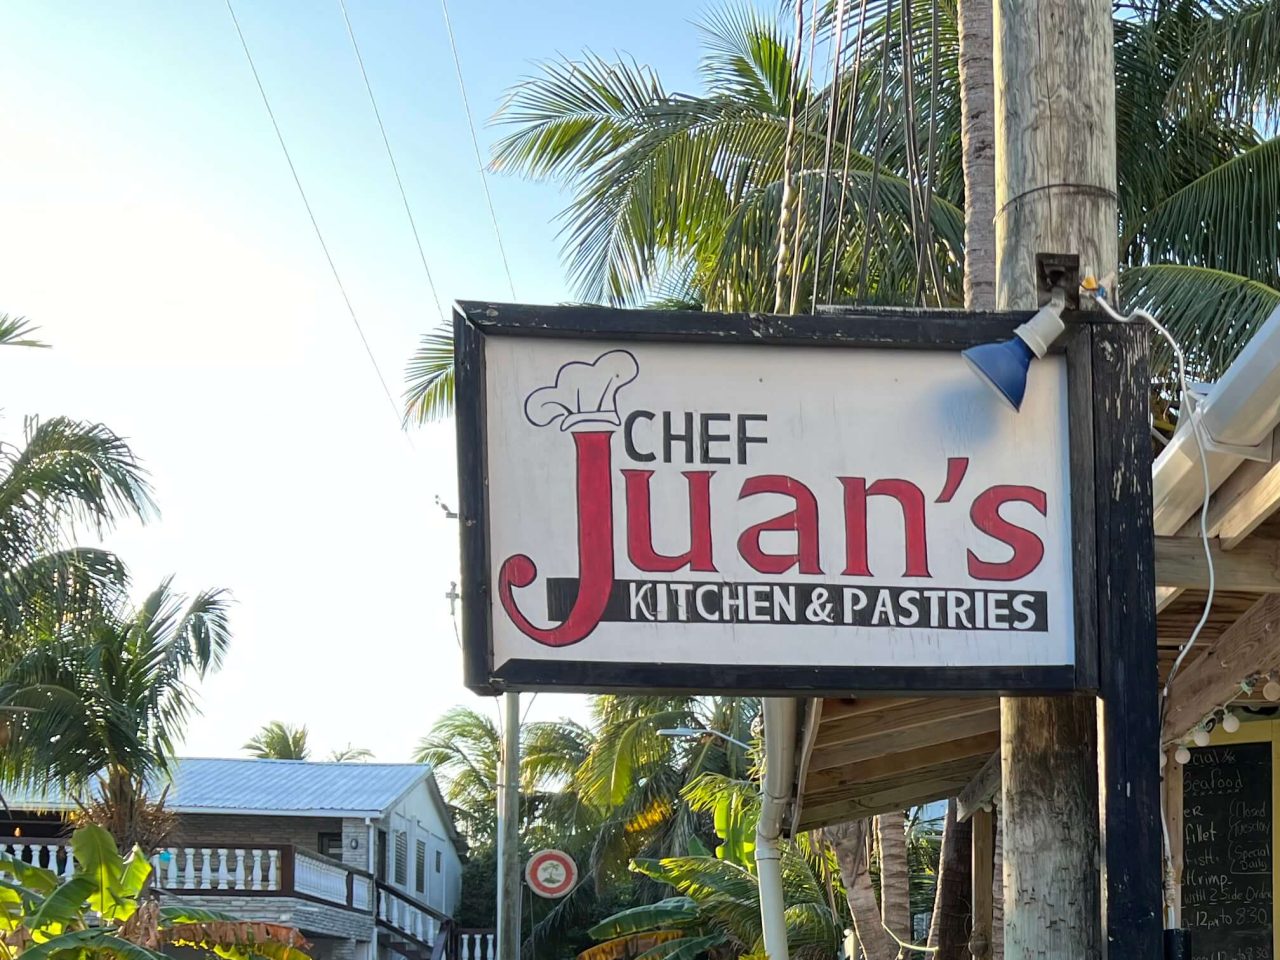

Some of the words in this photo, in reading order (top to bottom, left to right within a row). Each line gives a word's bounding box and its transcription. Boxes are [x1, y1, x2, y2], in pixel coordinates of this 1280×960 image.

[623, 410, 769, 465] CHEF
[499, 430, 1048, 647] Juan's
[628, 581, 797, 622] KITCHEN
[843, 588, 1037, 631] PASTRIES
